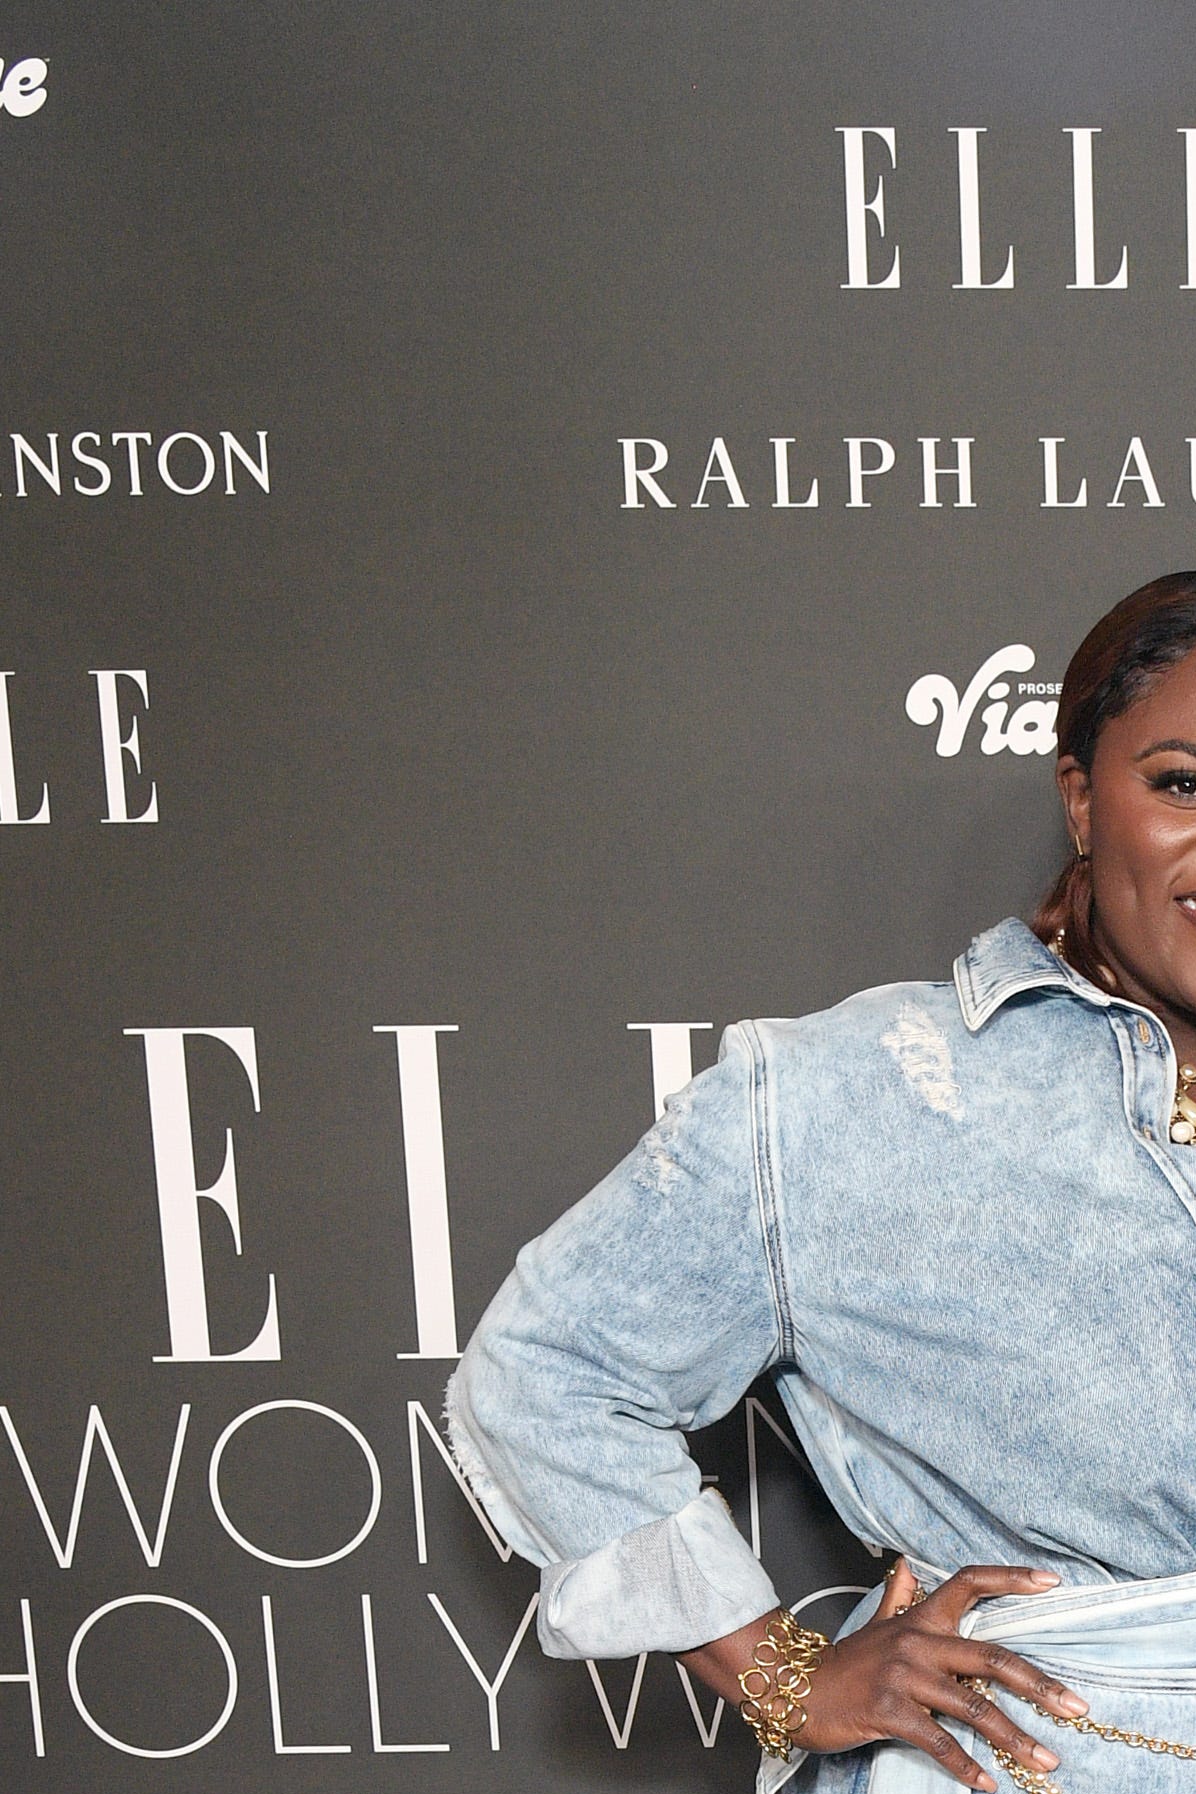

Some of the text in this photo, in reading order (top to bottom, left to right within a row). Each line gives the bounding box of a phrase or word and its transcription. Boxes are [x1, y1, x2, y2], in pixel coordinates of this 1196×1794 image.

[0, 430, 270, 497] NSTON
[617, 437, 978, 509] RALPH
[904, 643, 1062, 758] Via
[1017, 683, 1064, 695] PROSE
